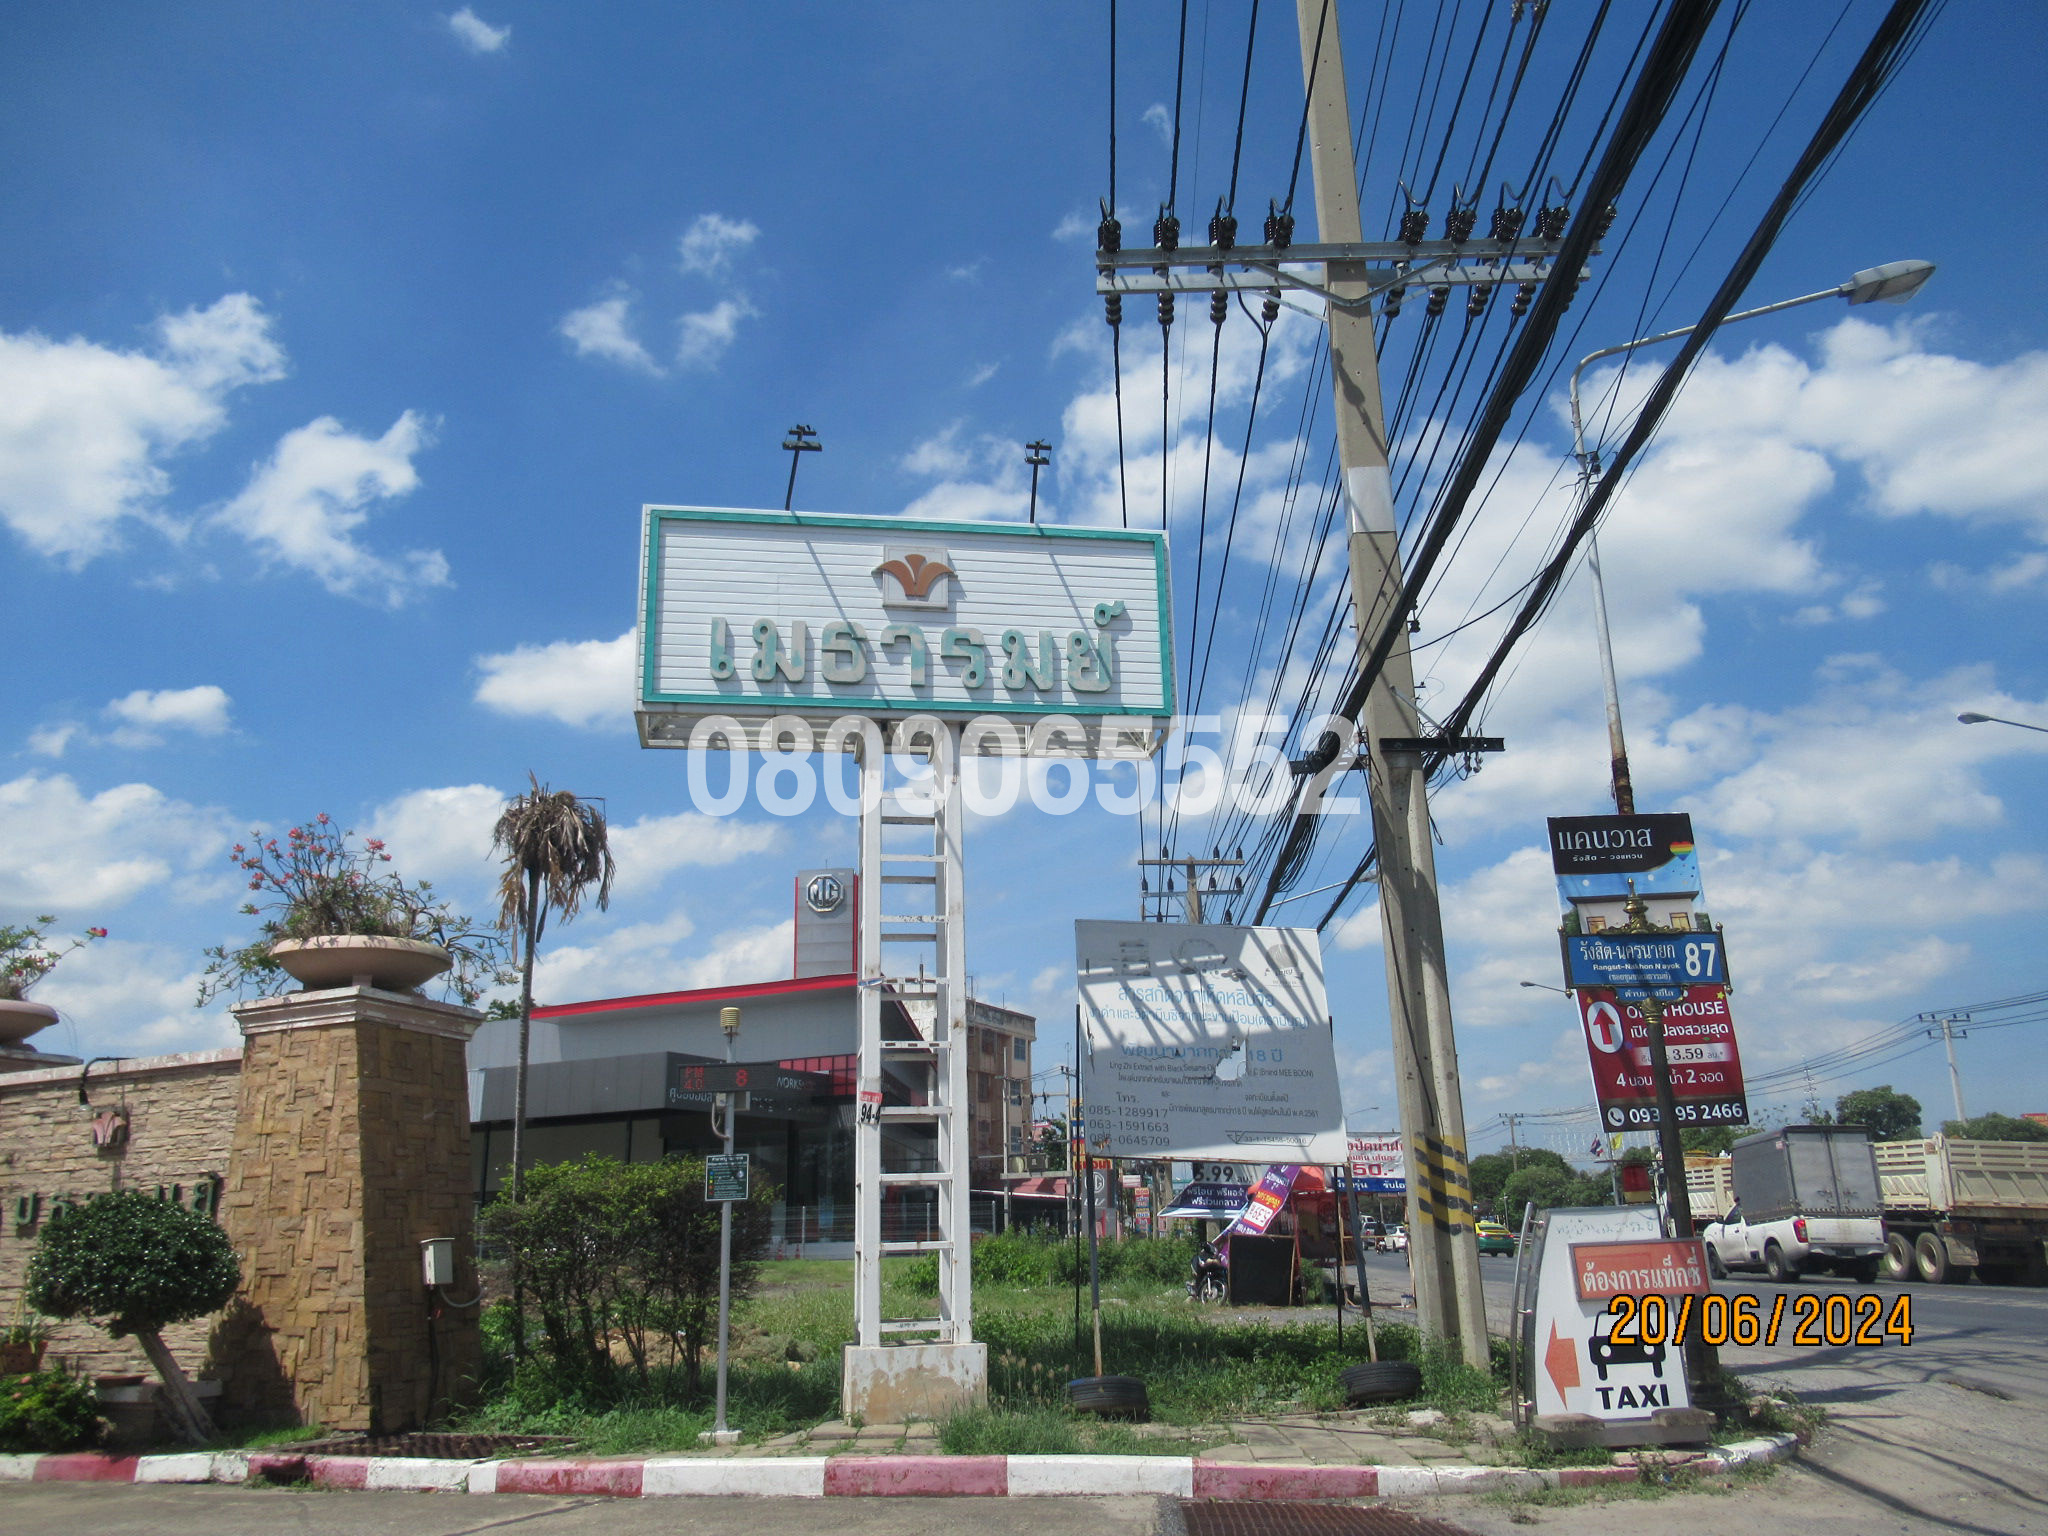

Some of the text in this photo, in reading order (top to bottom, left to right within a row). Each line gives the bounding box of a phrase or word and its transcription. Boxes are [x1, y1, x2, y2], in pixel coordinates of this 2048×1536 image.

[709, 600, 1125, 693] เมธารมย์
[1558, 828, 1653, 850] แคนวาส
[1580, 940, 1716, 977] รังสิต-นครนายก 87
[1671, 1001, 1725, 1017] HOUSE
[1672, 1047, 1703, 1061] 3.59
[736, 1069, 748, 1087] 8
[1616, 1073, 1627, 1087] 4
[1629, 1076, 1653, 1087] นอน
[1686, 1069, 1696, 1084] 2
[1699, 1072, 1724, 1083] จอด
[1088, 1105, 1168, 1118] 085-1289917
[1700, 1103, 1742, 1119] 2466
[1089, 1119, 1169, 1132] 063-1591663
[1582, 1246, 1701, 1292] ต้องการแท็กซี่
[1595, 1384, 1670, 1410] TAXI
